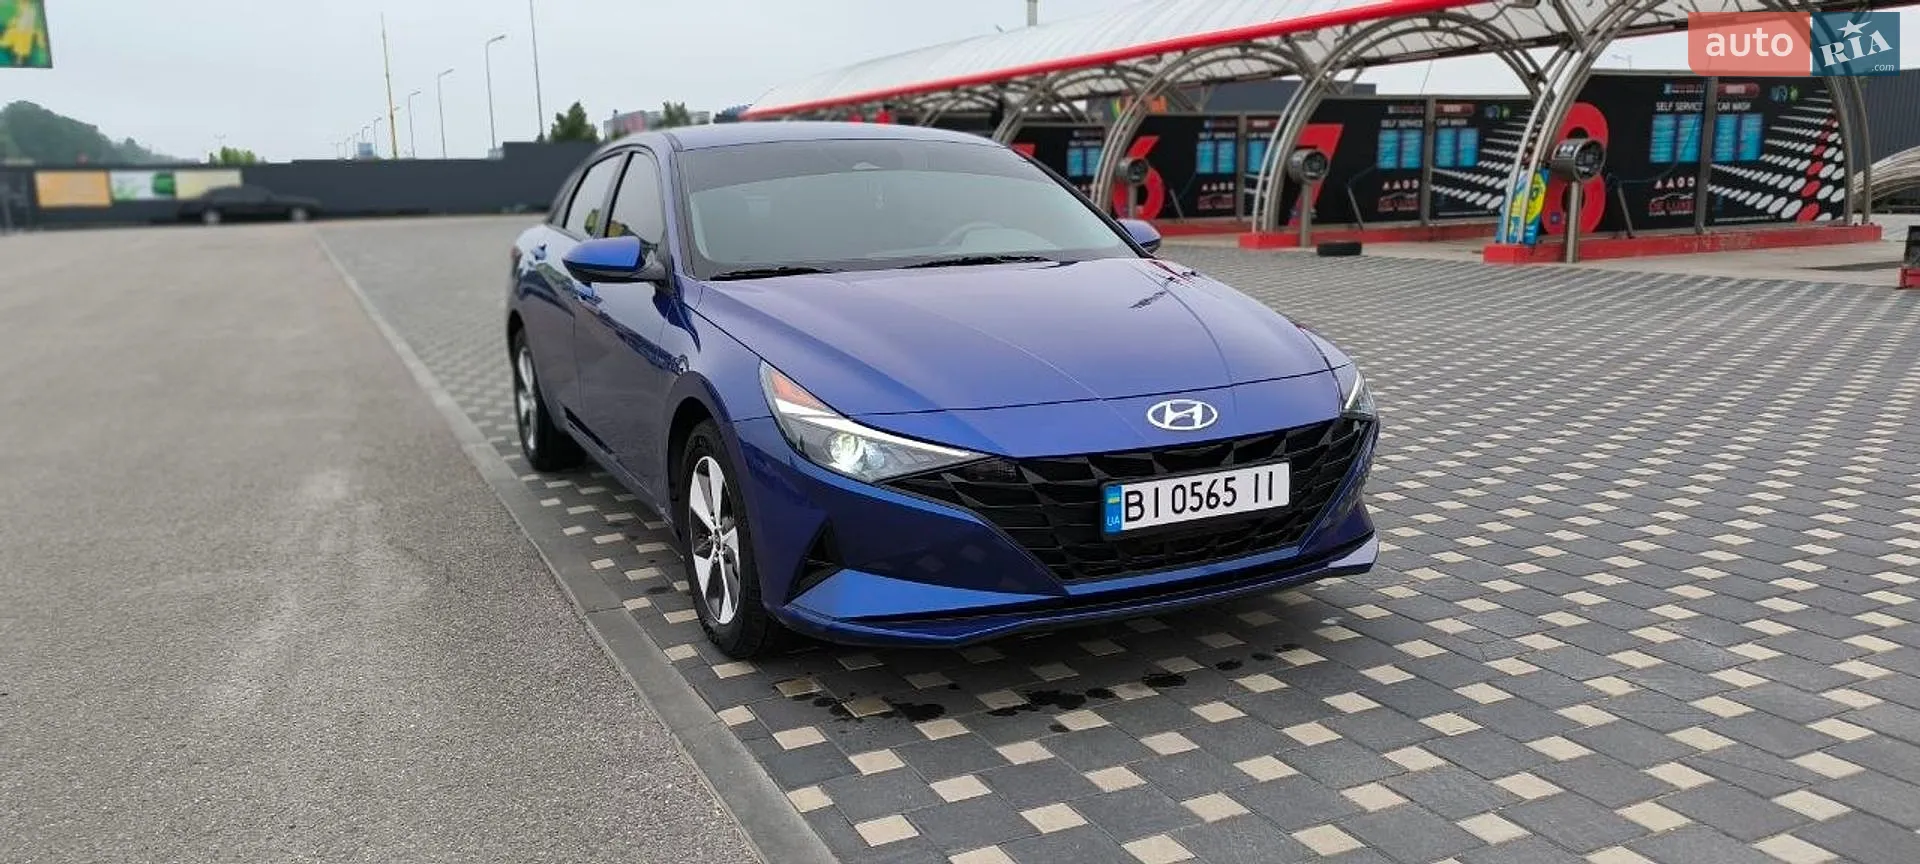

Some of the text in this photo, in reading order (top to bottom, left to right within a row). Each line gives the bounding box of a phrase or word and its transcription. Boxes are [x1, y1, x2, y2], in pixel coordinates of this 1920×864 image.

[1125, 487, 1160, 522] BI
[1171, 476, 1237, 514] 0565
[1106, 516, 1120, 526] UA
